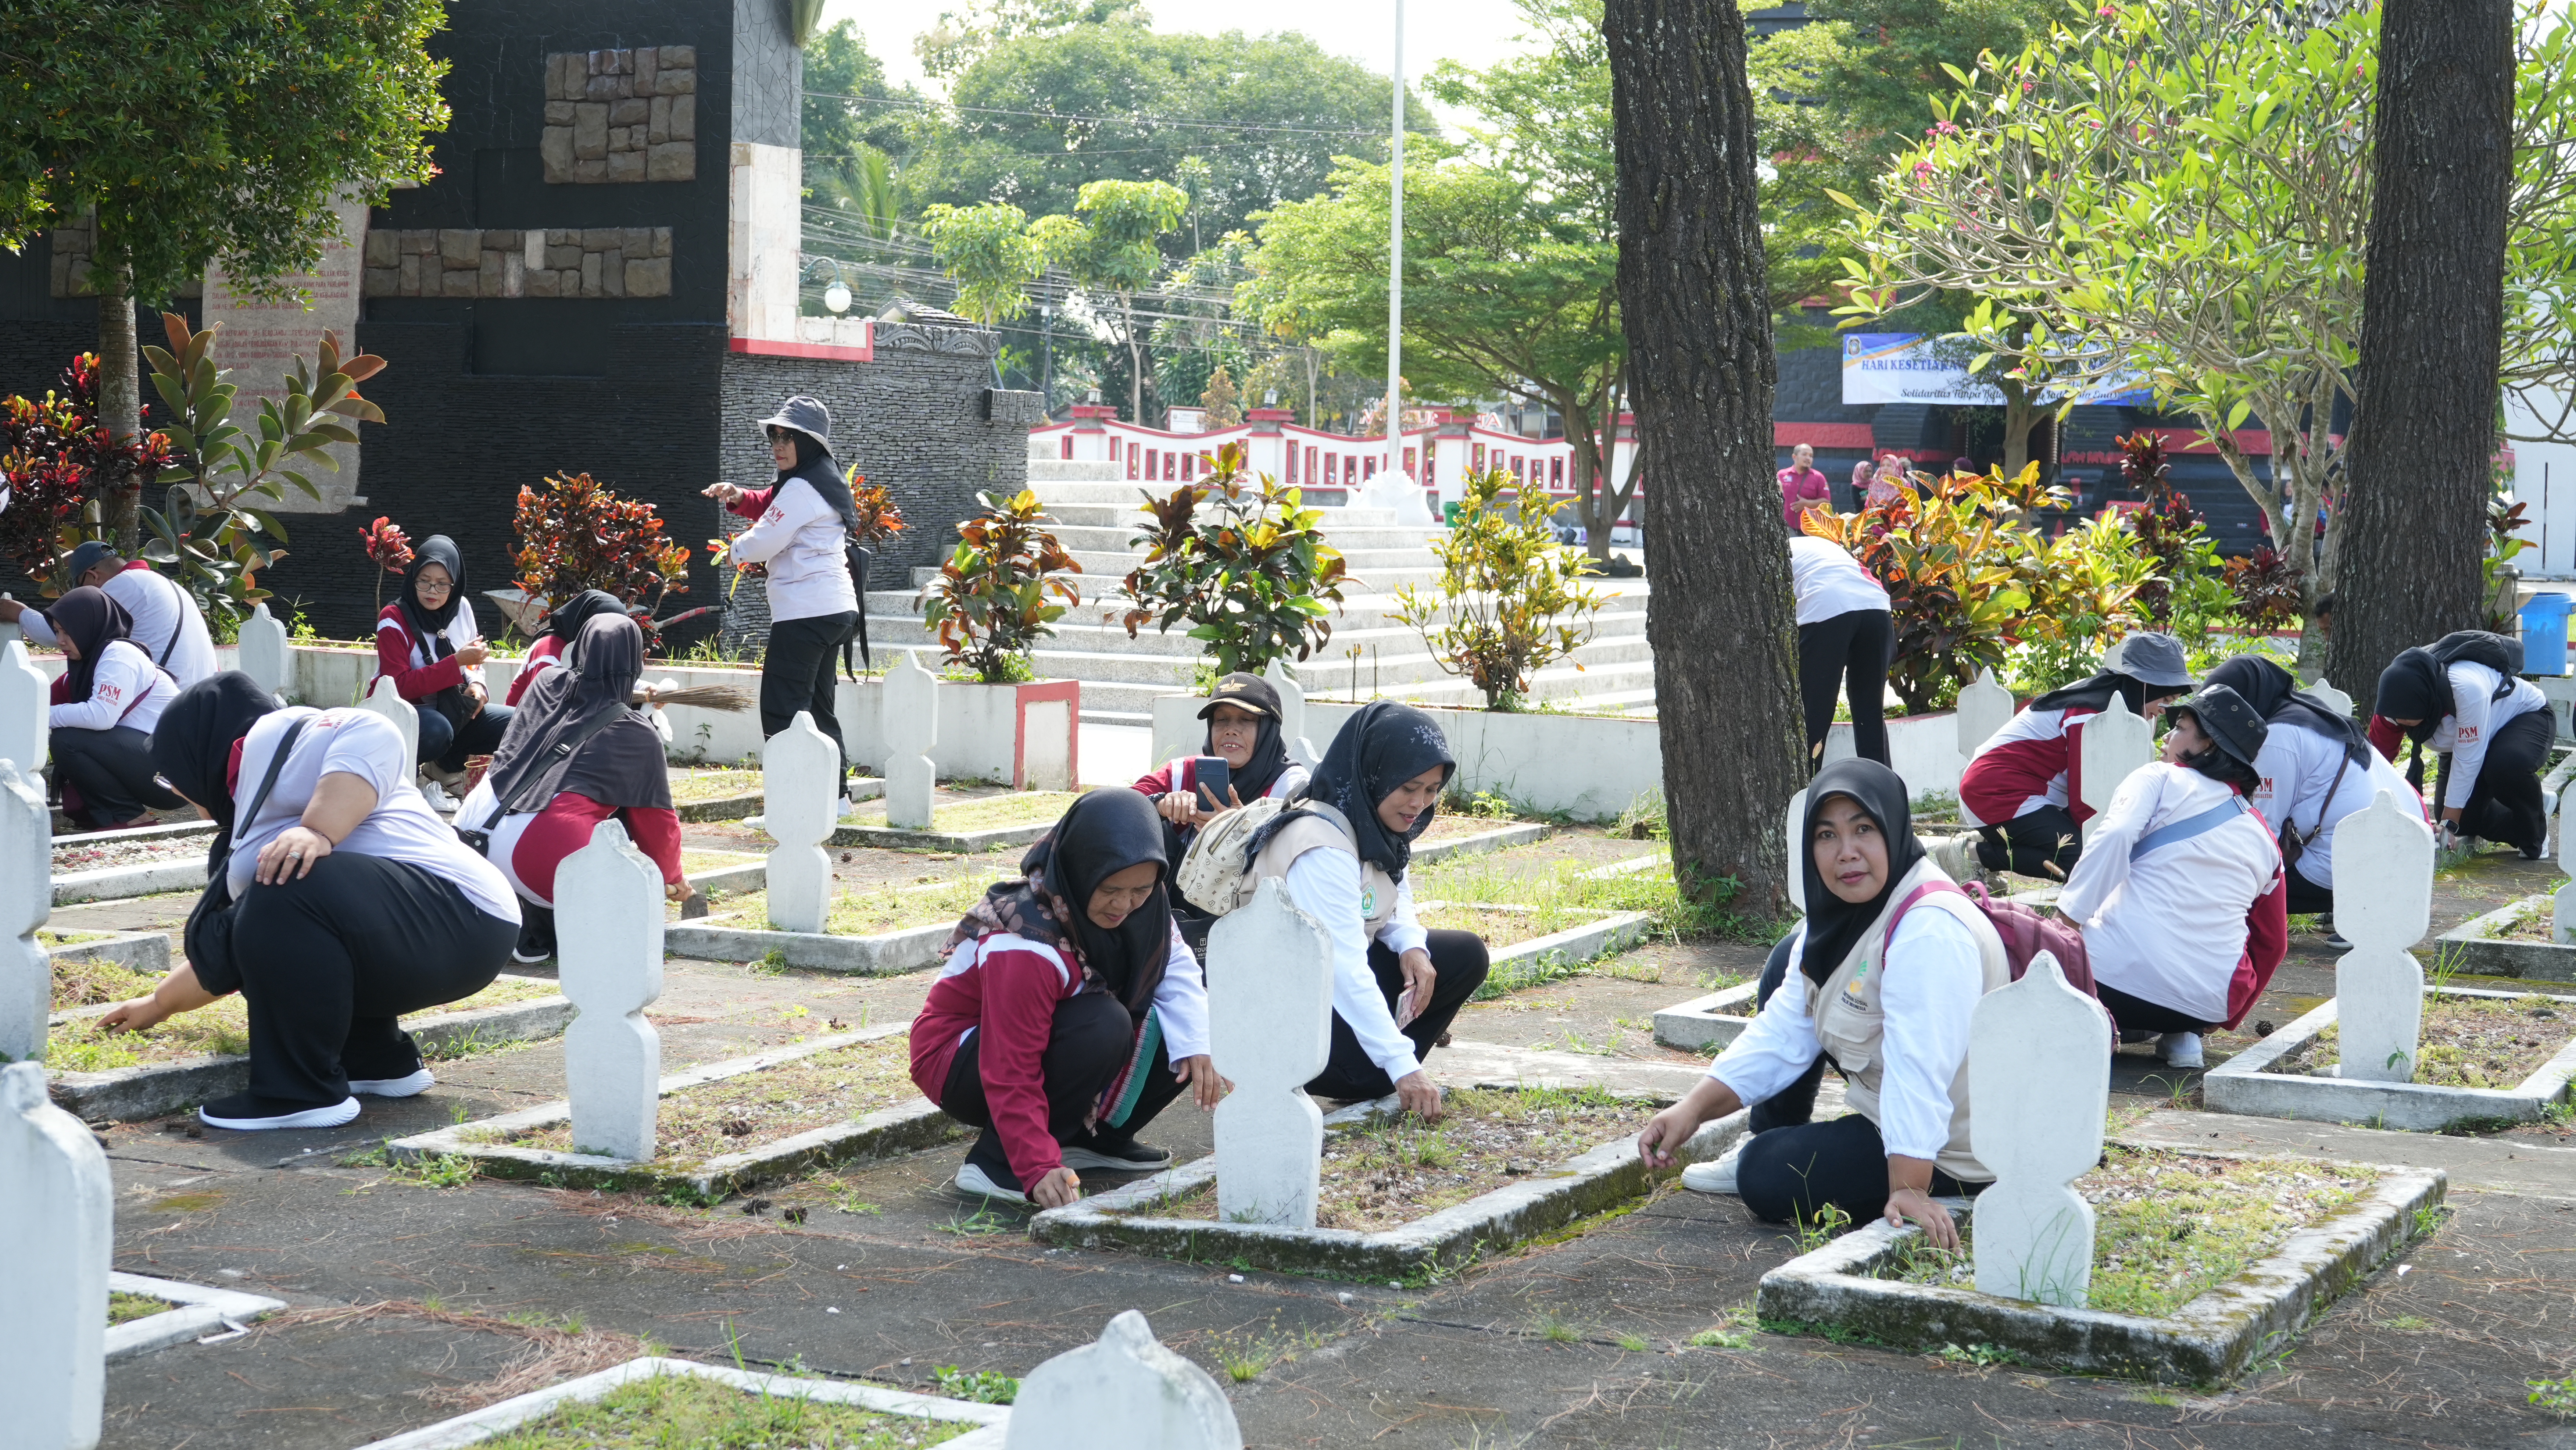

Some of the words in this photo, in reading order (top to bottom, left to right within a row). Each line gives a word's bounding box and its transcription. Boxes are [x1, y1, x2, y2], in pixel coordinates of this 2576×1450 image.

[1861, 359, 1888, 370] HARI
[1901, 388, 1951, 398] Solidaritas
[2093, 390, 2118, 399] Emas
[97, 684, 122, 701] PSM
[105, 698, 118, 706] BLITAR
[2458, 725, 2478, 738] PSM
[2259, 777, 2273, 792] SM
[1854, 998, 1868, 1007] SOSIAL
